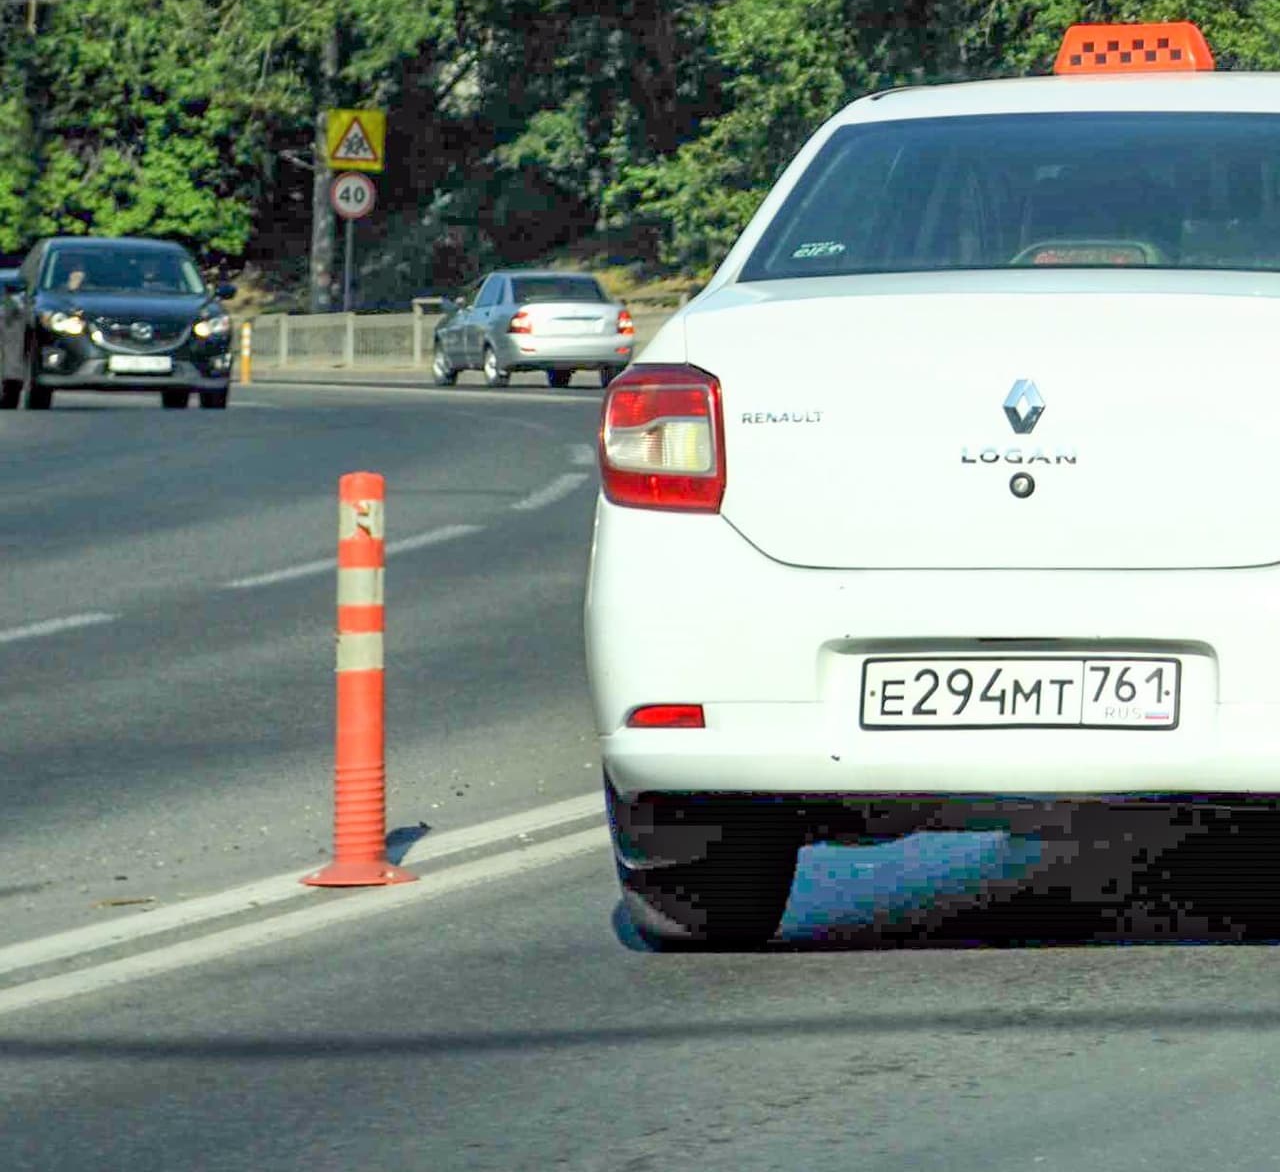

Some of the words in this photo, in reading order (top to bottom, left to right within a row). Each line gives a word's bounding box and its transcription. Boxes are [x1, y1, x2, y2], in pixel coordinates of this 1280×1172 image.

[339, 186, 366, 204] 40
[741, 411, 824, 424] RENAULT
[961, 446, 1077, 464] LOGAN
[880, 668, 1074, 716] Е294МТ
[1090, 666, 1164, 704] 761
[1104, 706, 1142, 720] RUS
